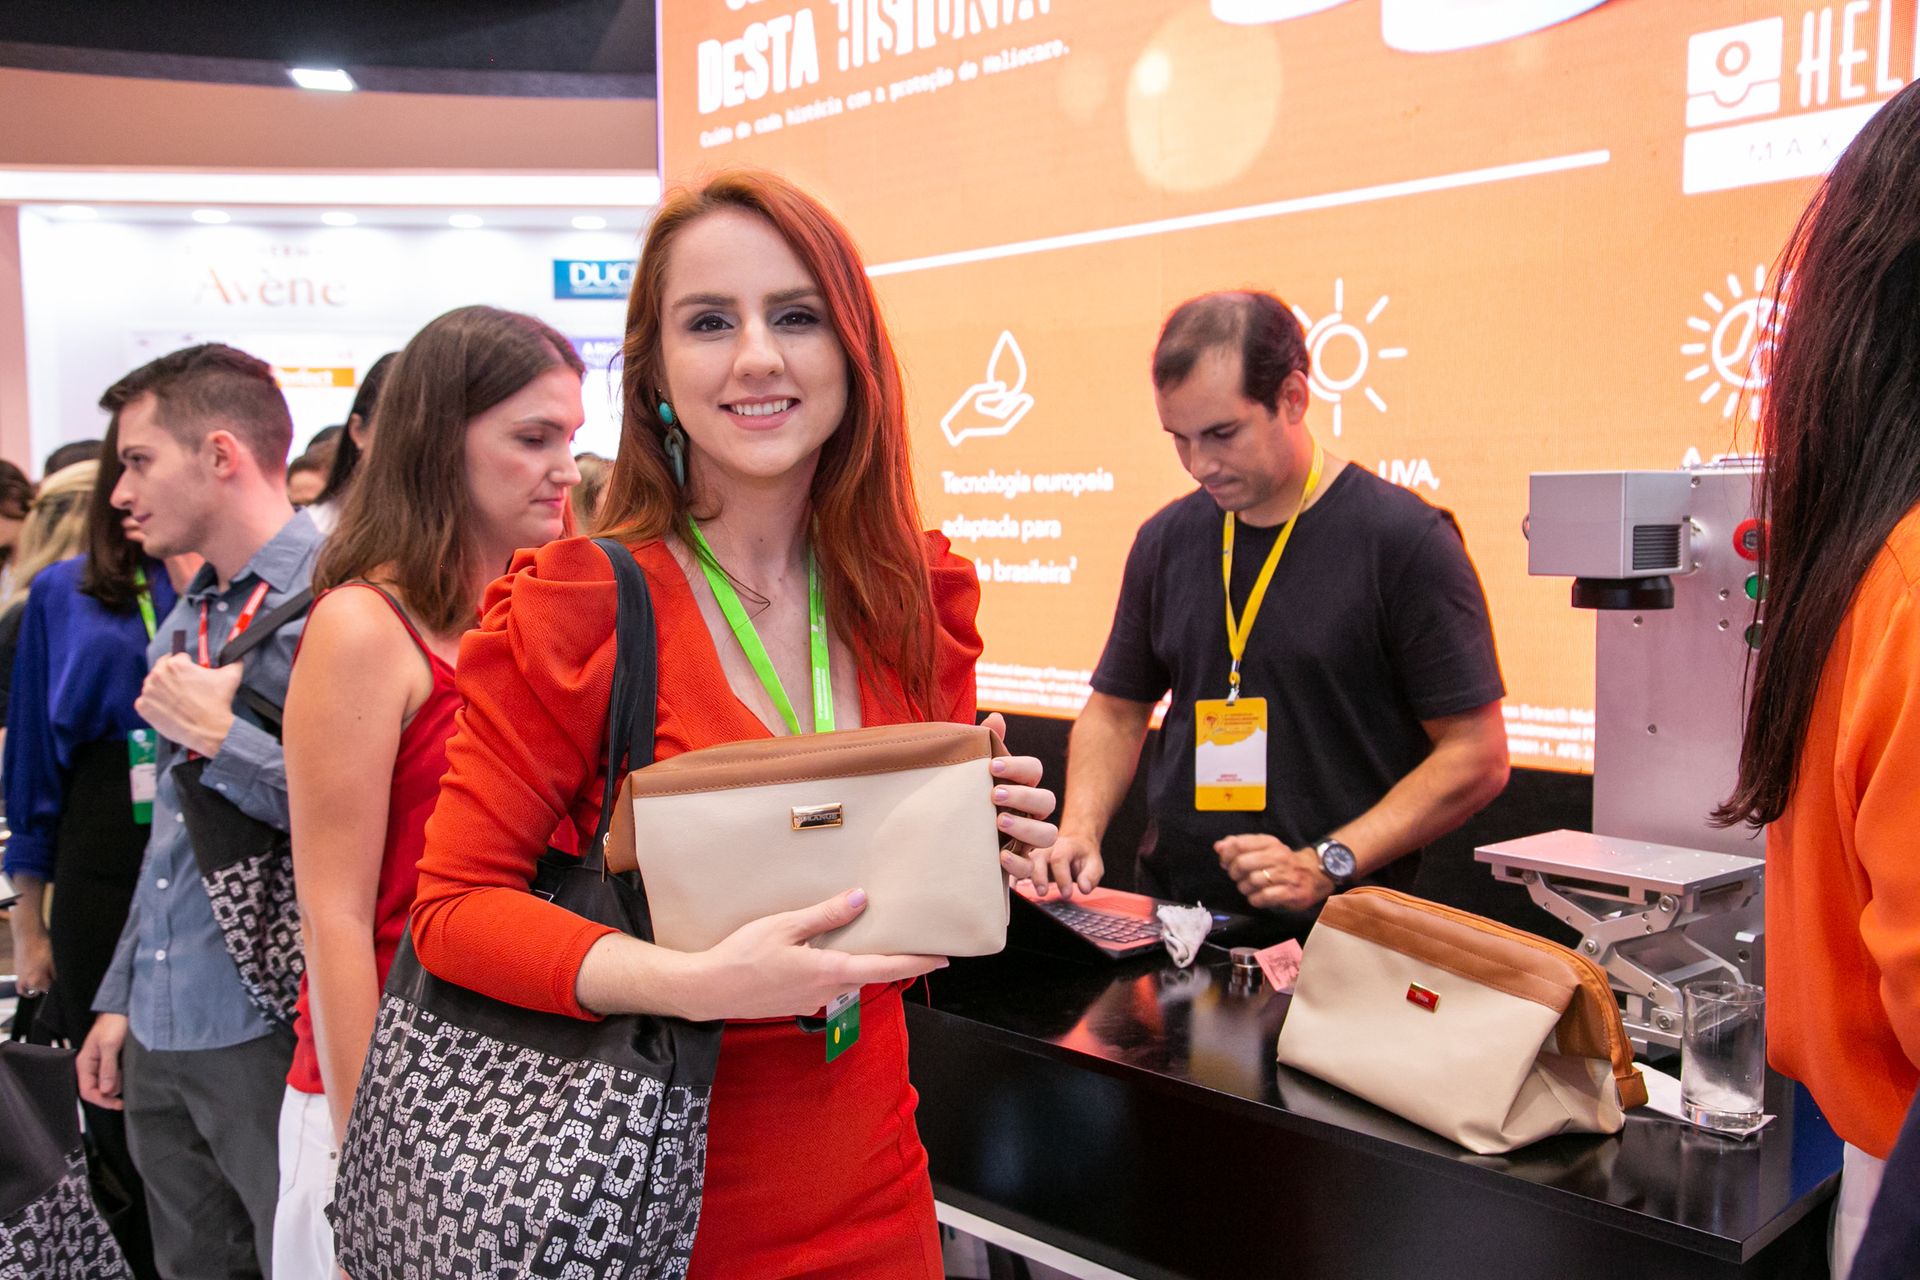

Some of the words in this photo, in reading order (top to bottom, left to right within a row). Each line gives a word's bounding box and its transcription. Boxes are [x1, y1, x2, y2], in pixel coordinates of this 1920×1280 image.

[698, 8, 820, 114] DESTA
[1796, 0, 1920, 108] HEL
[941, 469, 1031, 500] Tecnologia
[1033, 466, 1114, 497] europeia
[942, 513, 1020, 543] adaptada
[1021, 519, 1062, 544] para
